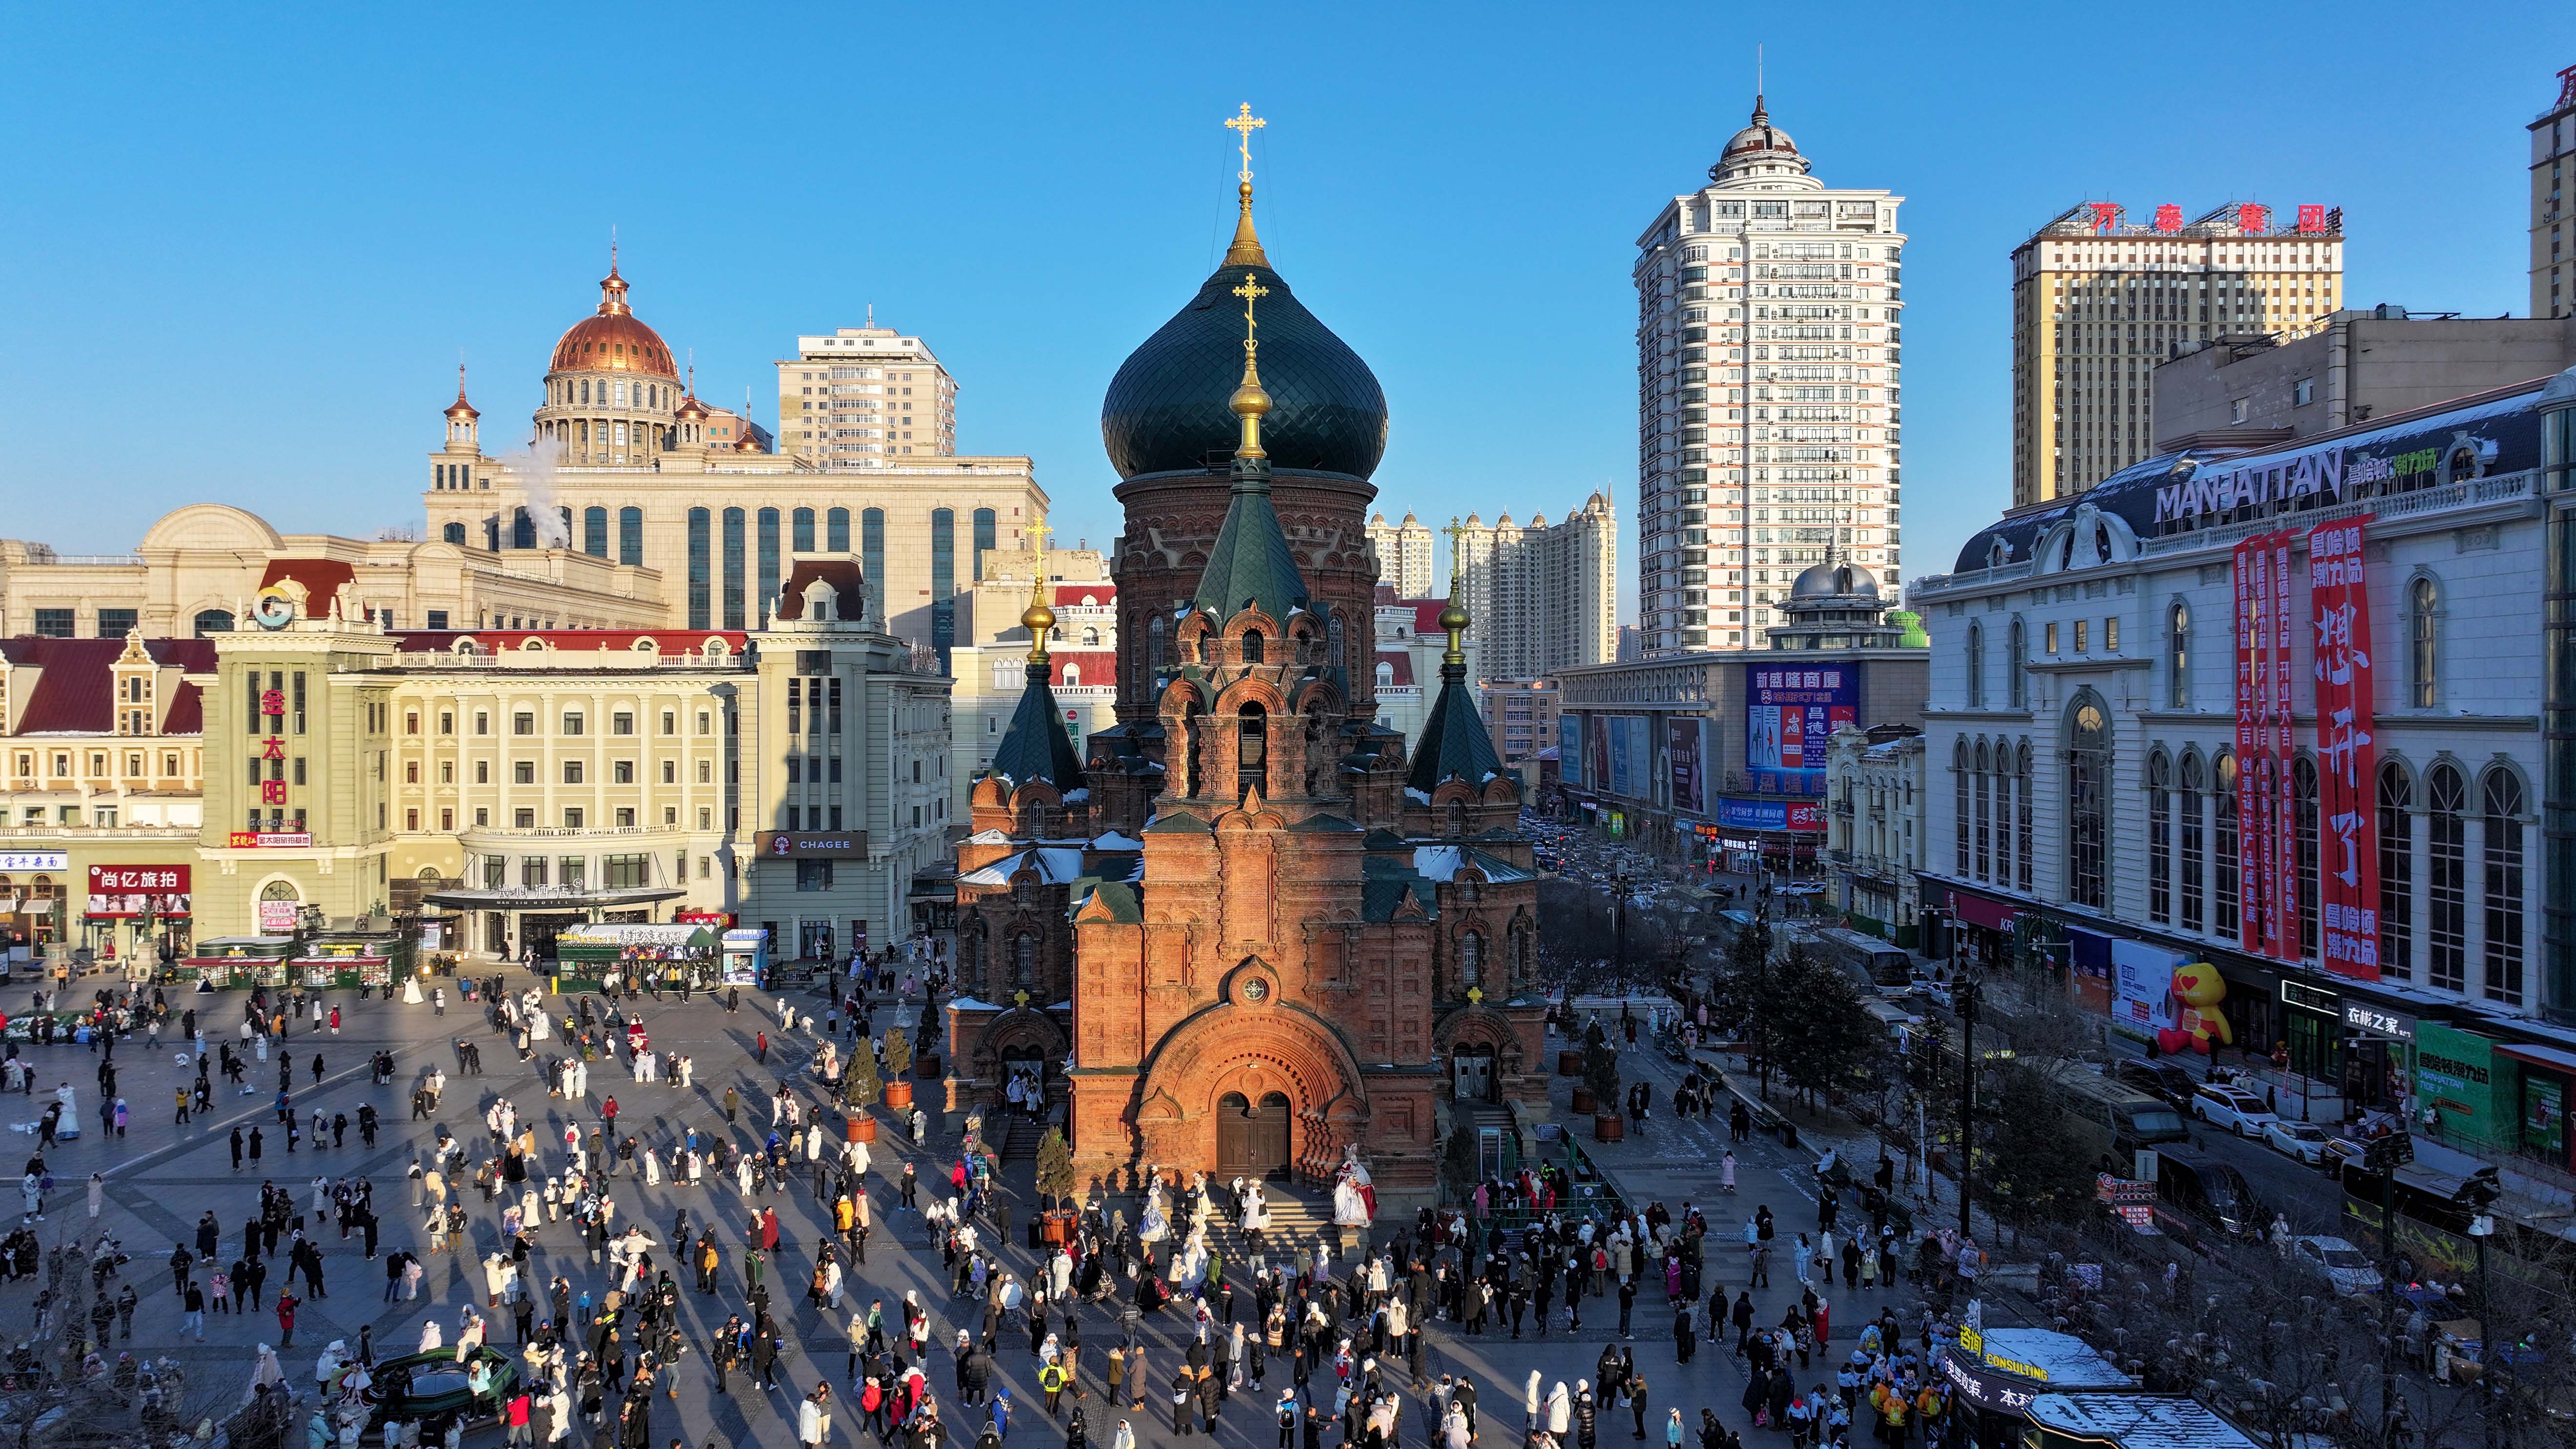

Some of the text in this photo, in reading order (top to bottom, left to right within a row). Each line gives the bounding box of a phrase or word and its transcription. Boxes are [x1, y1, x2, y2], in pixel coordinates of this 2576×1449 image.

[2090, 203, 2325, 233] 万泰集团
[2153, 446, 2346, 523] MANHATTAN
[2311, 527, 2360, 558] 曼哈顿
[2312, 557, 2364, 588] 潮力场
[1756, 672, 1840, 688] 新盛隆商厦
[1772, 692, 1812, 703] 塔斯汀
[2239, 662, 2251, 745] 开业大吉
[2279, 662, 2291, 747] 开业大吉
[1806, 707, 1827, 735] 昌德
[262, 690, 286, 805] 金太阳
[1755, 808, 1784, 819] 亚洲同心
[2241, 757, 2256, 924] 创意设计产品成果展
[101, 871, 178, 888] 尚亿旅拍
[498, 884, 569, 899] 漫心酒店
[2325, 903, 2375, 936] 曼哈顿
[2327, 932, 2377, 967] 潮力场
[2348, 1007, 2398, 1034] 衣彬之家
[2419, 1052, 2489, 1085] 曼哈顿潮力场
[2419, 1070, 2464, 1091] MANHATTAN
[1960, 1324, 1984, 1358] 咨询
[1987, 1353, 2049, 1381] CONSULTING
